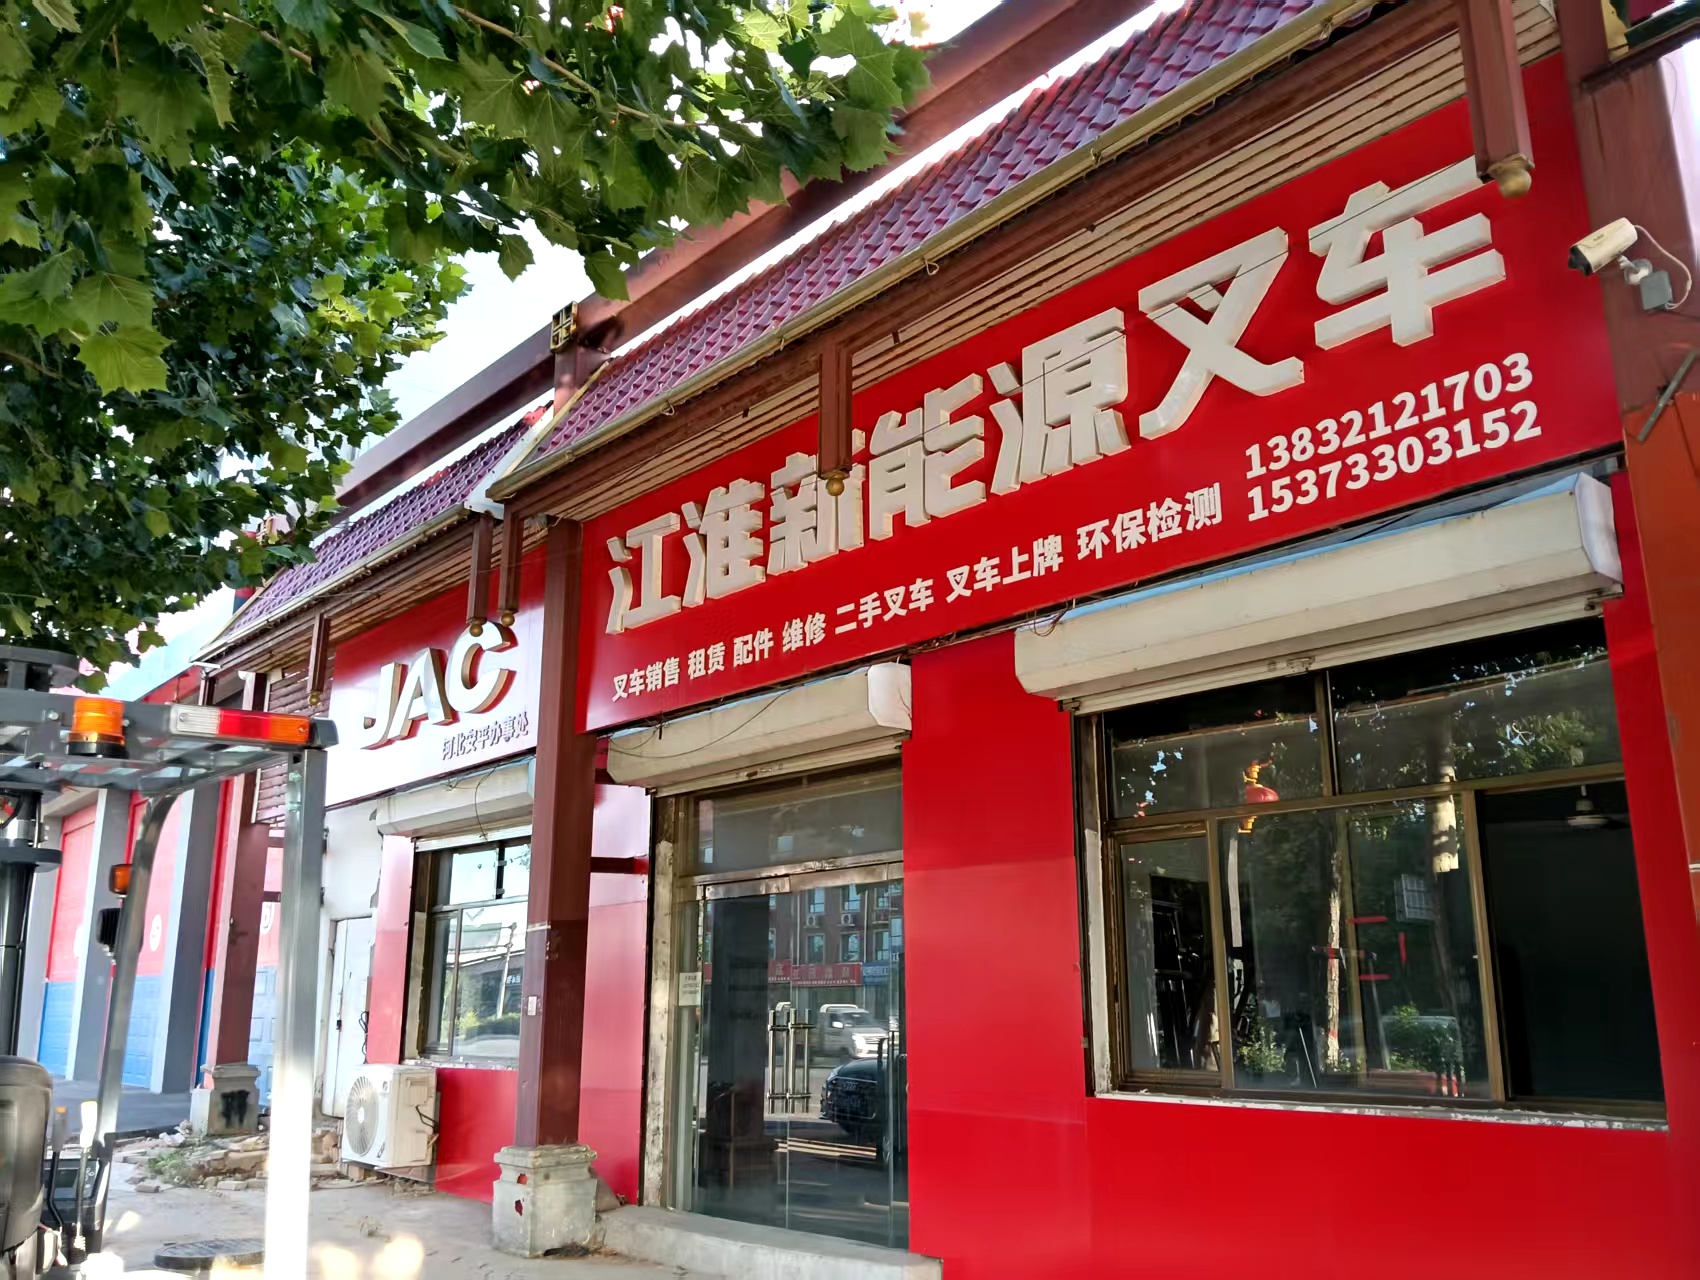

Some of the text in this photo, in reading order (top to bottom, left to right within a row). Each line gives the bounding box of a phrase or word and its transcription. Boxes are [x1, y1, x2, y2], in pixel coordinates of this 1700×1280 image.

[606, 156, 1506, 634] 江淮新能源叉车
[1244, 352, 1533, 480] 13832121703
[1247, 400, 1542, 522] 15373303152
[612, 482, 1223, 702] 叉车销售 租赁 配件 维修 二手叉车 叉车上牌 环保检测
[360, 621, 518, 749] JAC
[442, 707, 529, 761] 河北安平办事处
